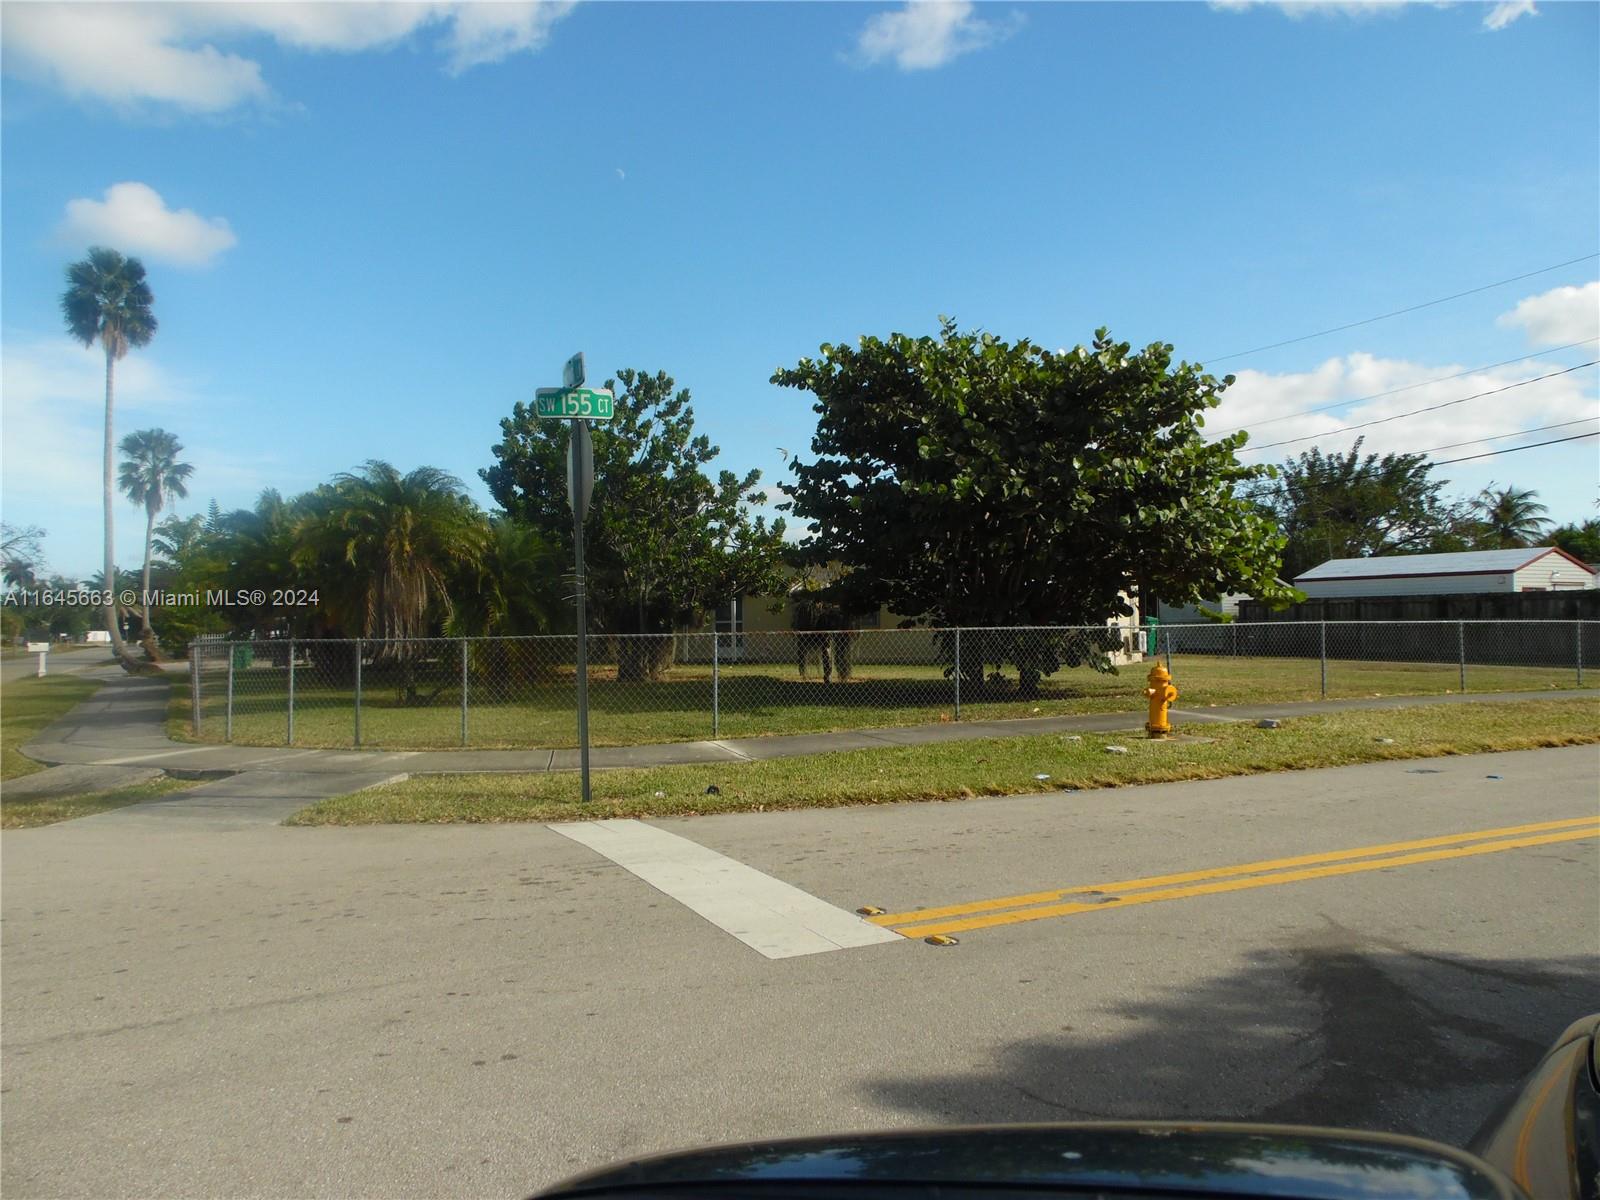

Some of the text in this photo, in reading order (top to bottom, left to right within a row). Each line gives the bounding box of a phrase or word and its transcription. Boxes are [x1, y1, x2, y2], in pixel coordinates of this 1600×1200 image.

[539, 393, 609, 415] SW 155 CT
